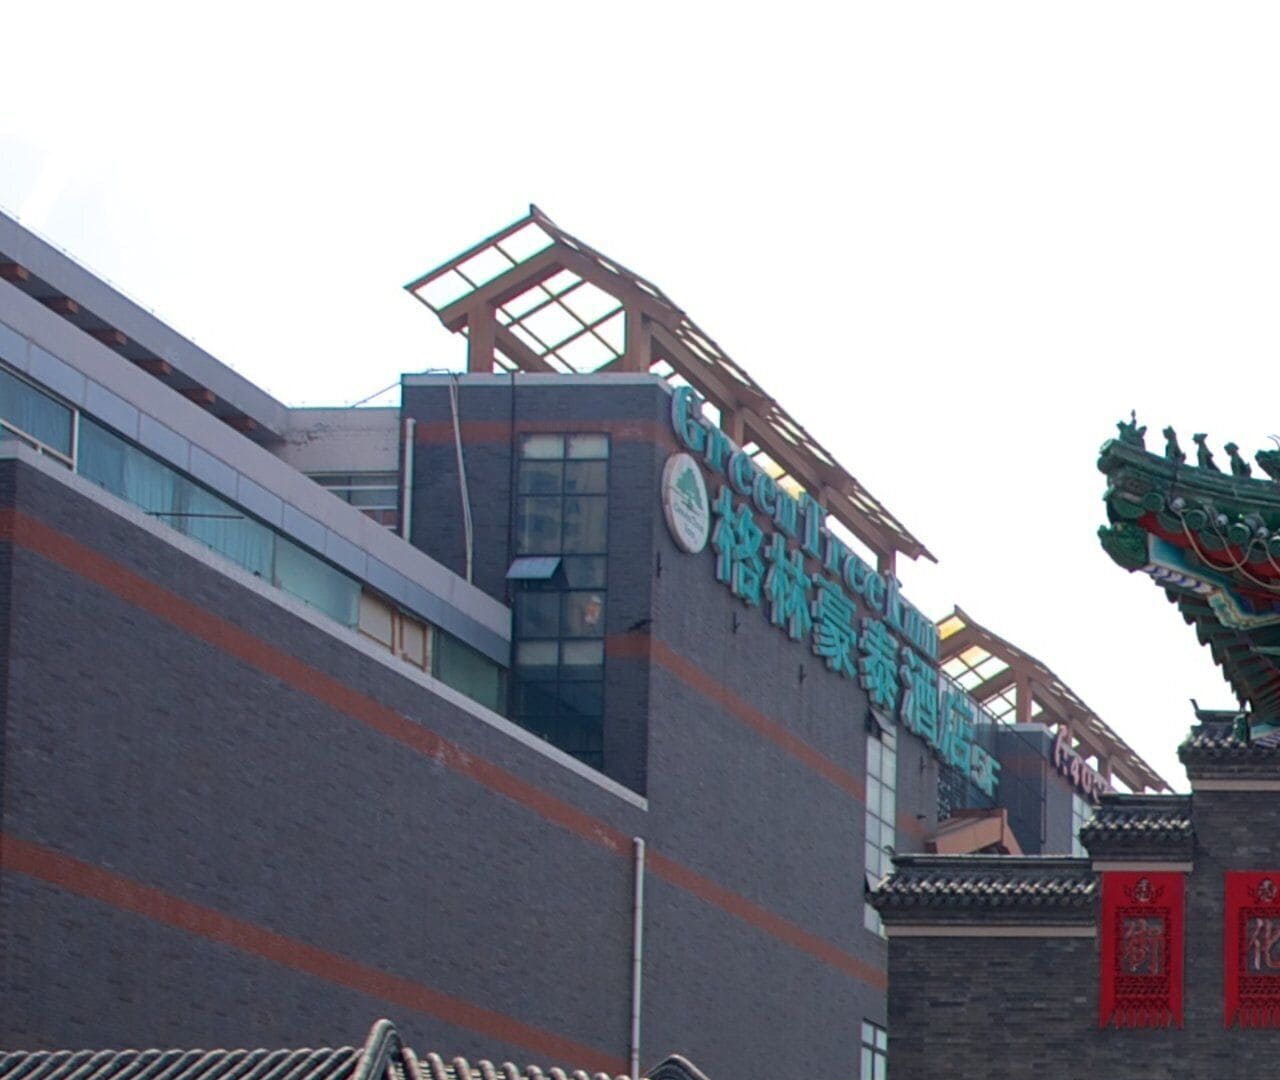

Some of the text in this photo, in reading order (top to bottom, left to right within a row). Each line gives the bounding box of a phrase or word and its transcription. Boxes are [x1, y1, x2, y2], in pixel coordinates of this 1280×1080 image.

[711, 484, 1001, 796] 格林豪泰酒店 5F
